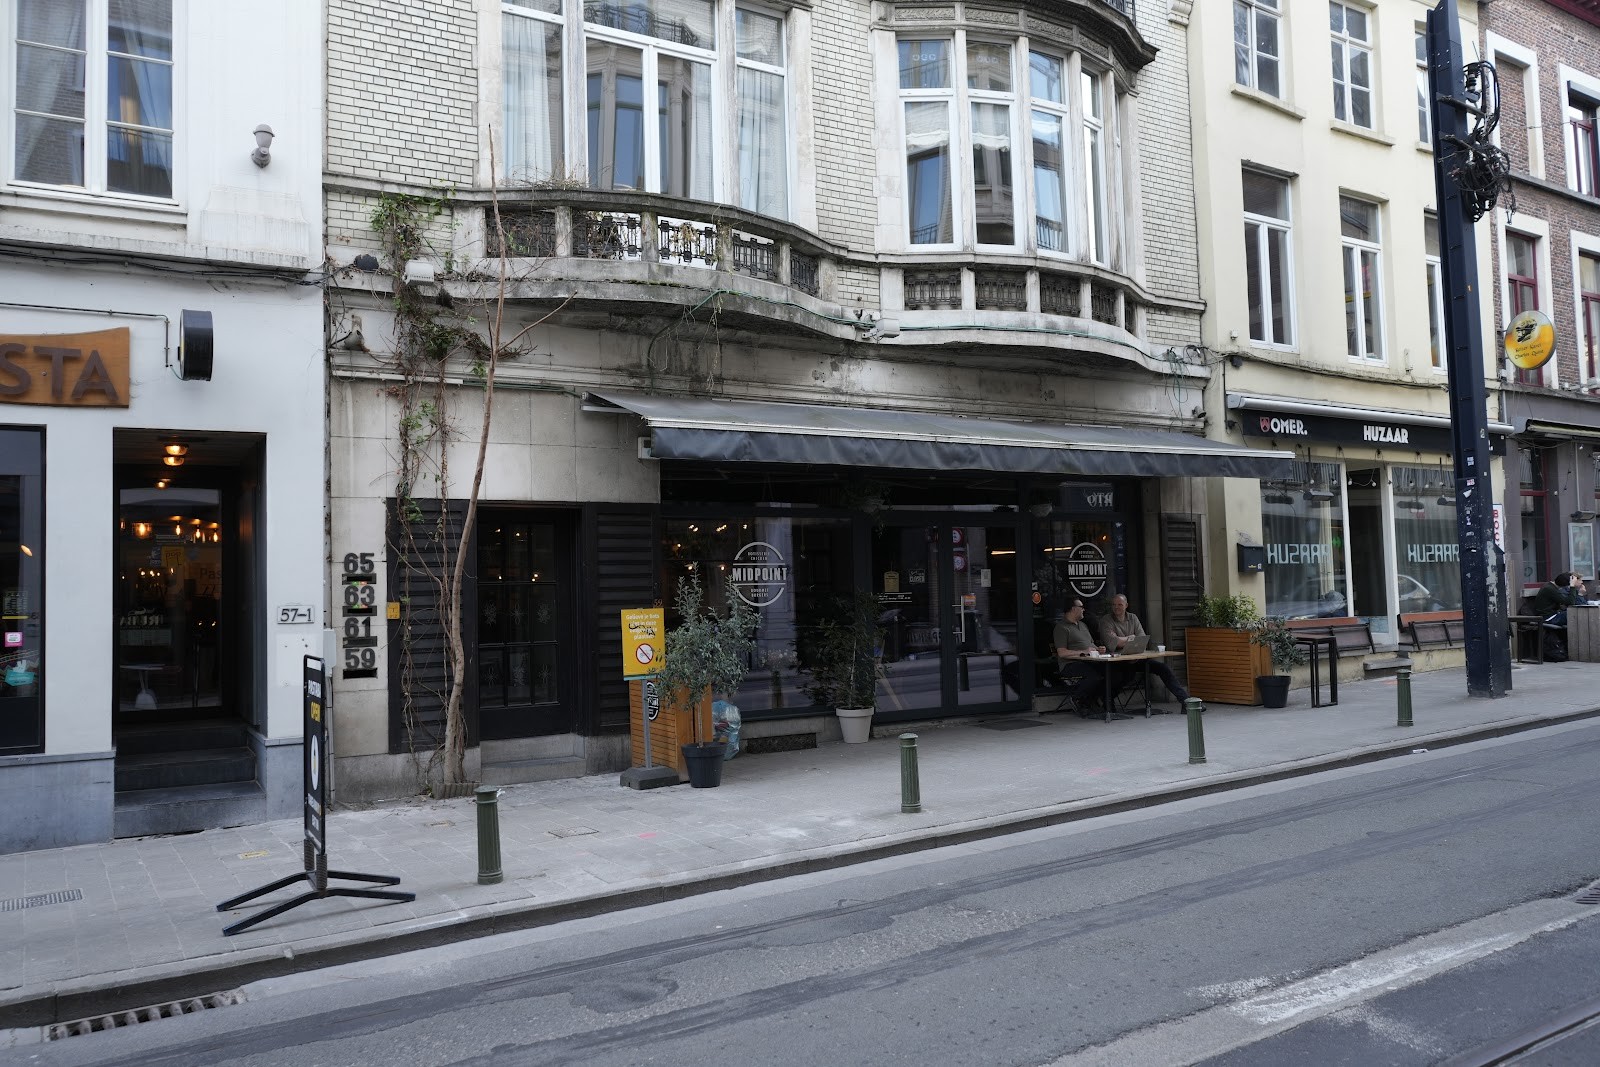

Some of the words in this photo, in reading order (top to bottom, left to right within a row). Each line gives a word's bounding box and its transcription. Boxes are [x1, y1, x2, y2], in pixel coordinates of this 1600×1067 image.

[0, 342, 119, 401] STA
[1270, 418, 1308, 435] OMER.
[1363, 425, 1409, 444] HUZAAR
[343, 552, 375, 573] 65
[1266, 544, 1331, 564] HUZAAR
[1407, 544, 1460, 562] HUZAAR
[732, 567, 788, 582] MIDPOINT
[1067, 563, 1108, 576] MIDPOINT
[344, 585, 375, 606] 63
[280, 608, 312, 622] 57-1
[344, 616, 371, 638] 61
[345, 648, 376, 669] 59
